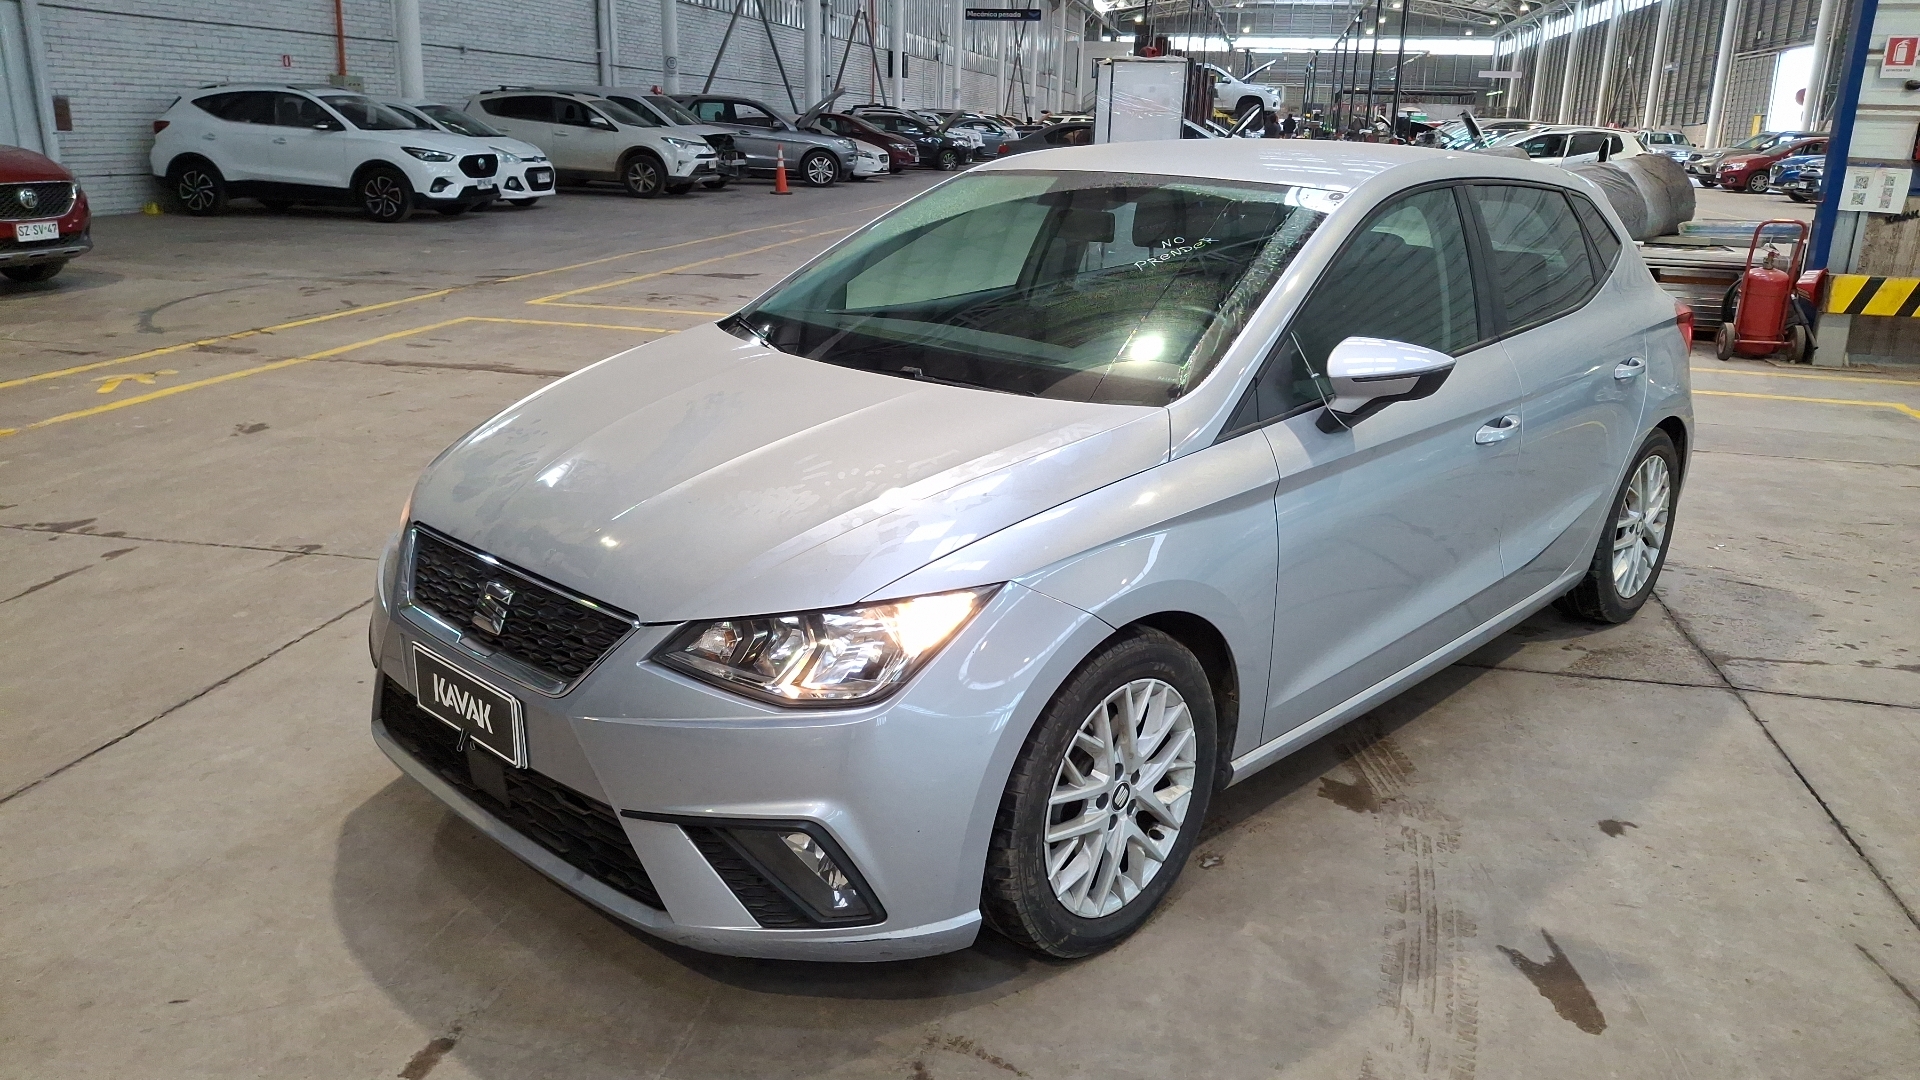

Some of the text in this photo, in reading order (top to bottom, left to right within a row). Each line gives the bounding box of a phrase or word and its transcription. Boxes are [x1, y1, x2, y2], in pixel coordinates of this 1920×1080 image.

[998, 11, 1022, 19] pesada
[1161, 236, 1186, 249] NO
[433, 672, 494, 735] KAVAK
